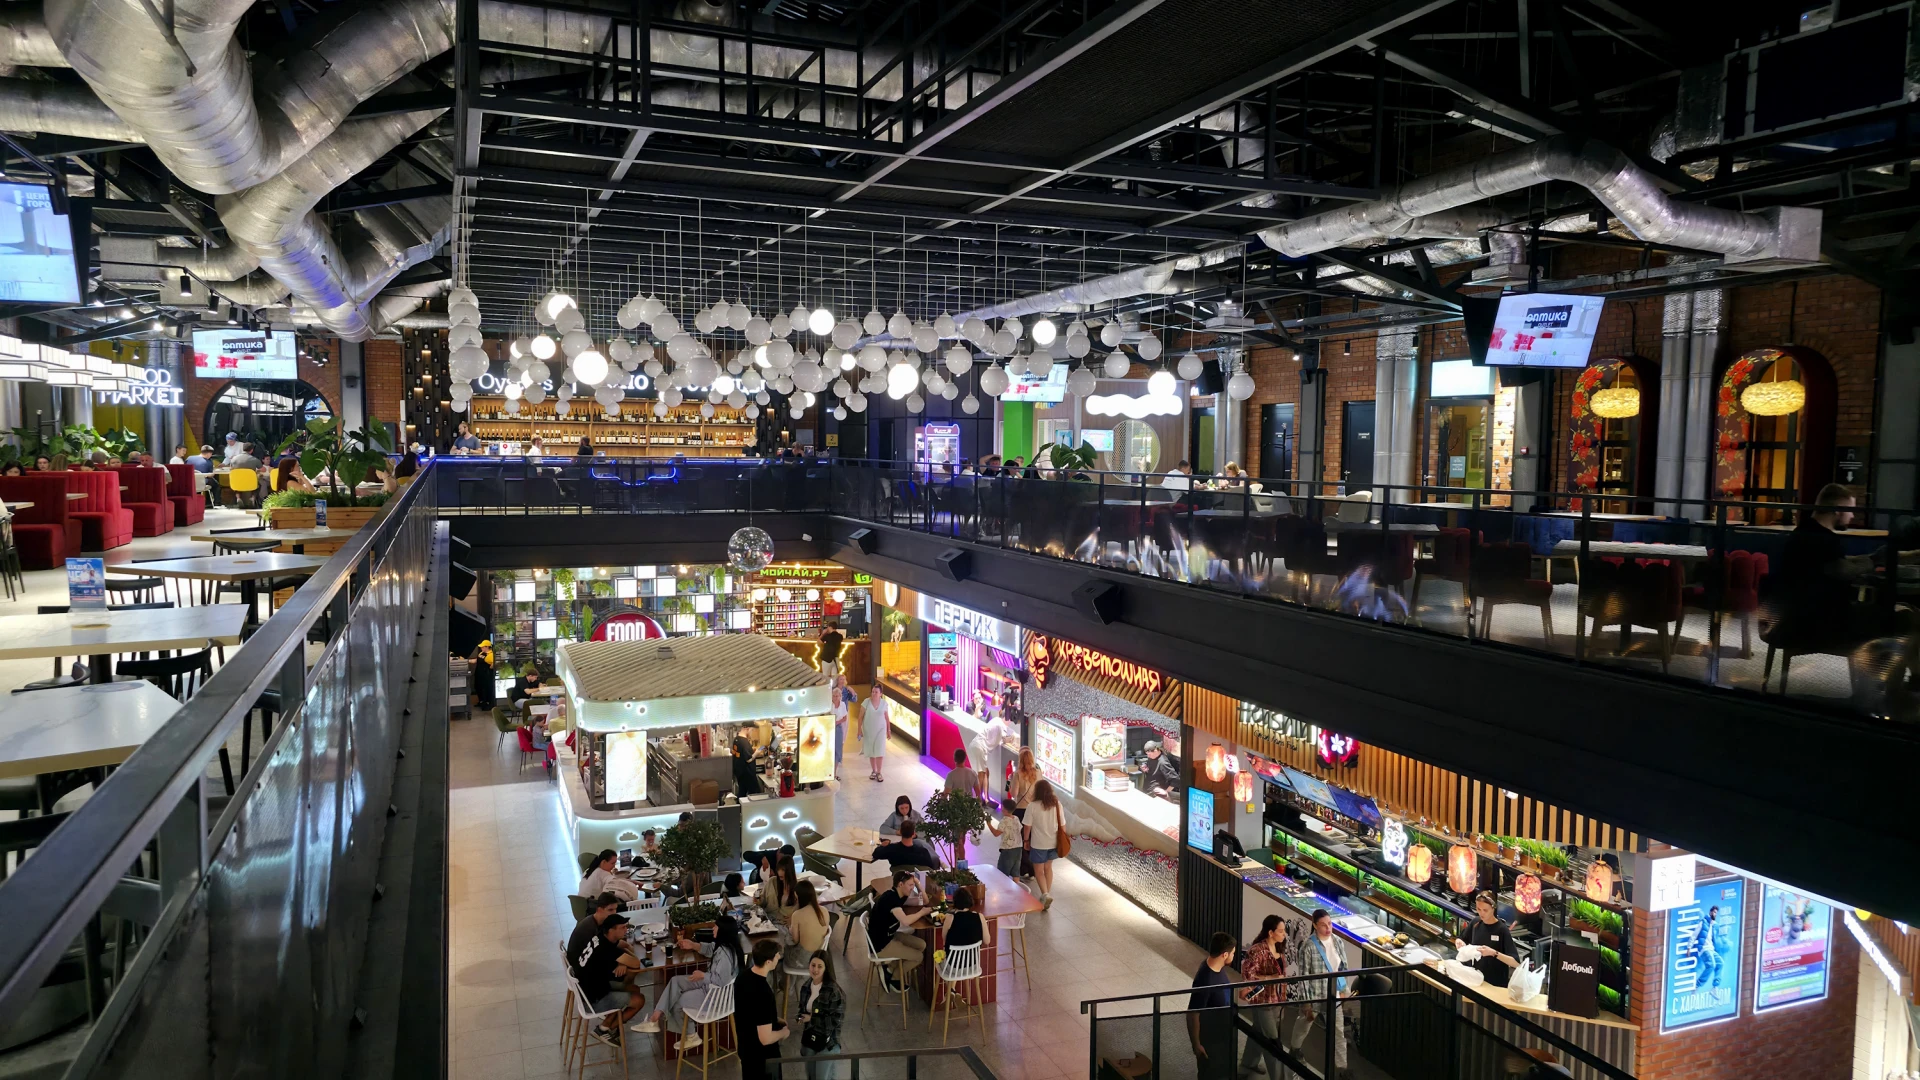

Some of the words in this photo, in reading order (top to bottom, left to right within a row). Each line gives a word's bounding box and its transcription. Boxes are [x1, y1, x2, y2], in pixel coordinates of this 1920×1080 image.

[26, 191, 50, 201] ЦЕНТ
[760, 567, 829, 577] МОЙЧАЙ.РУ
[606, 621, 646, 641] FOOD
[1674, 899, 1701, 993] ШОПИН
[1561, 960, 1594, 975] Добрый
[1672, 996, 1679, 1014] С
[1679, 987, 1731, 1013] ХАРАКТЕОМ
